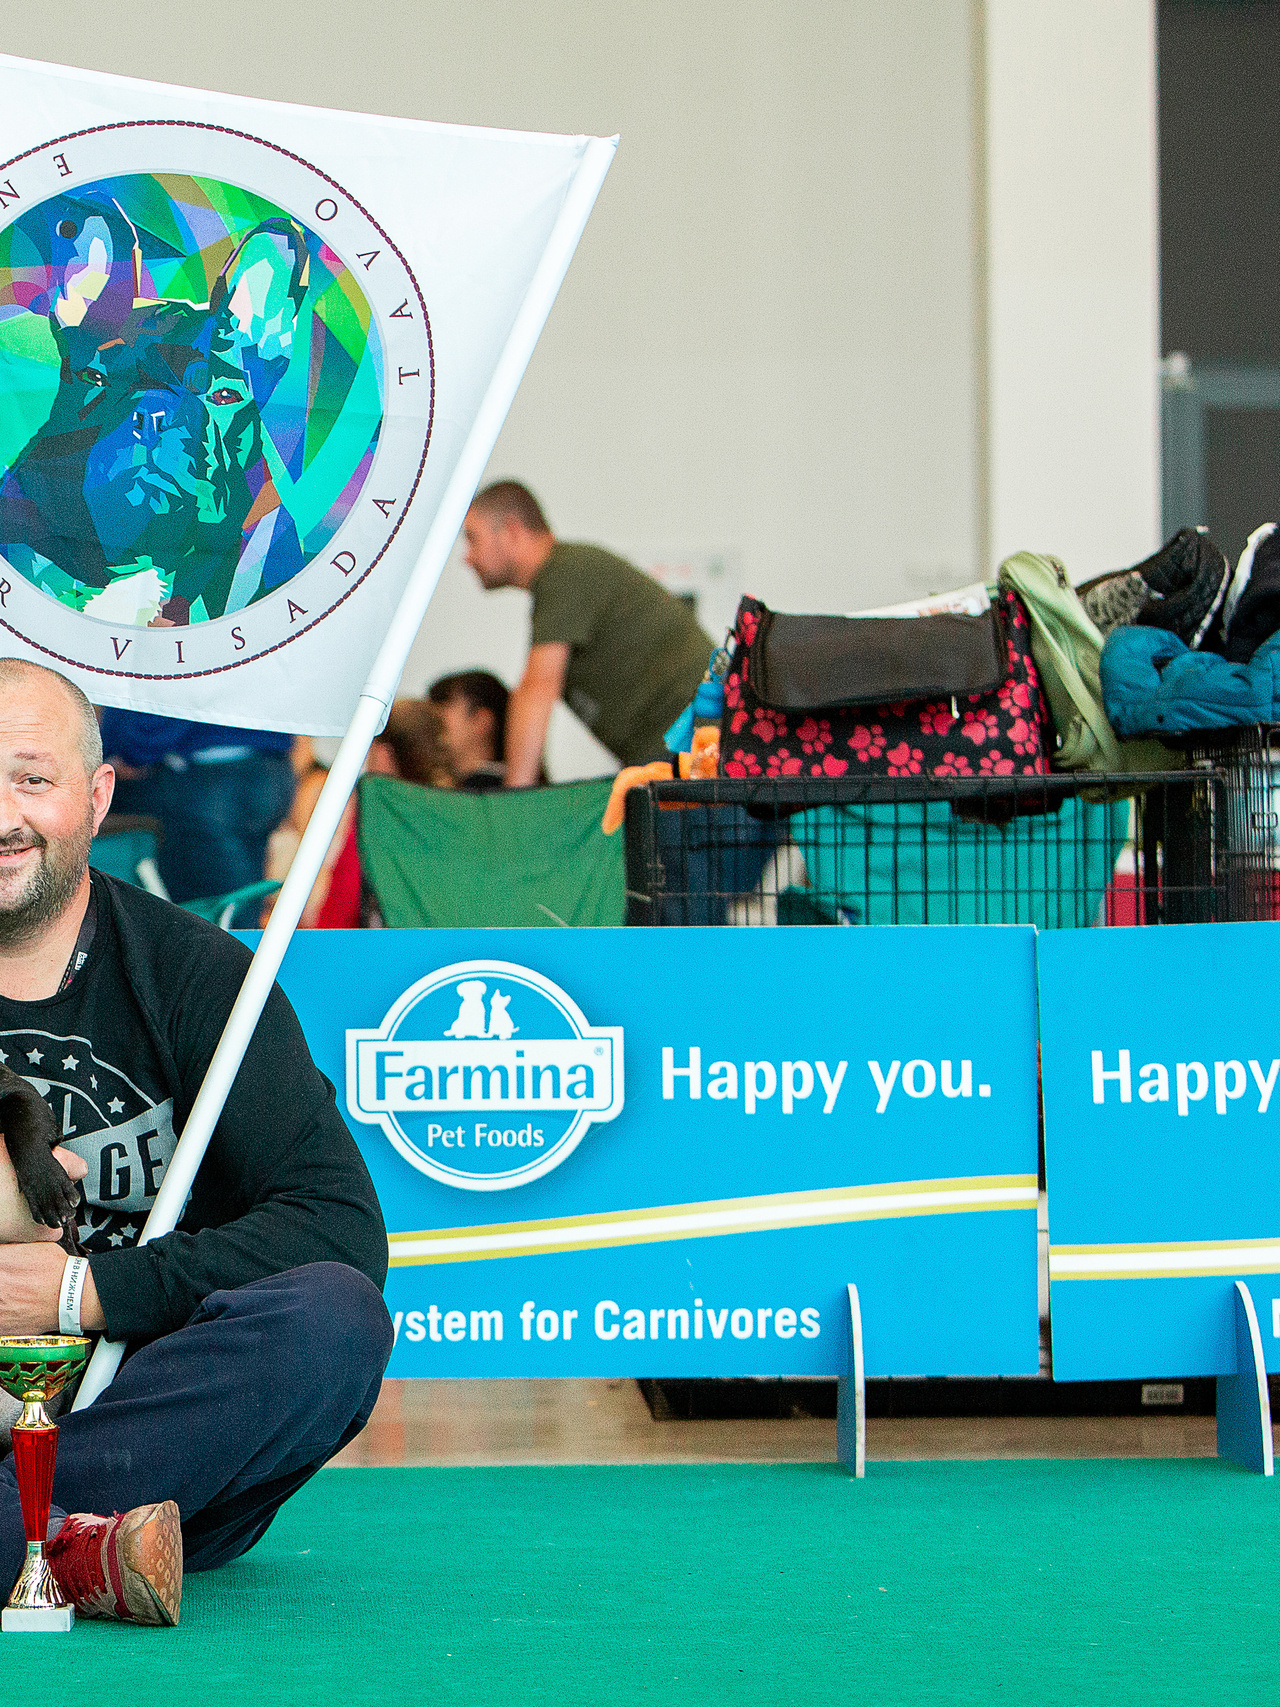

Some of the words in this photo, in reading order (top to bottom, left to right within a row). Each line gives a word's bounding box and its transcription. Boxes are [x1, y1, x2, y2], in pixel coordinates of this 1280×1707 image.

[109, 495, 396, 663] VISADA
[375, 1049, 595, 1101] Farmina
[662, 1046, 848, 1115] Happy
[867, 1059, 991, 1114] you.
[1091, 1049, 1280, 1116] Happy
[427, 1124, 466, 1148] Pet
[475, 1122, 545, 1148] Foods
[519, 1300, 578, 1341] for
[594, 1298, 821, 1341] Carnivores
